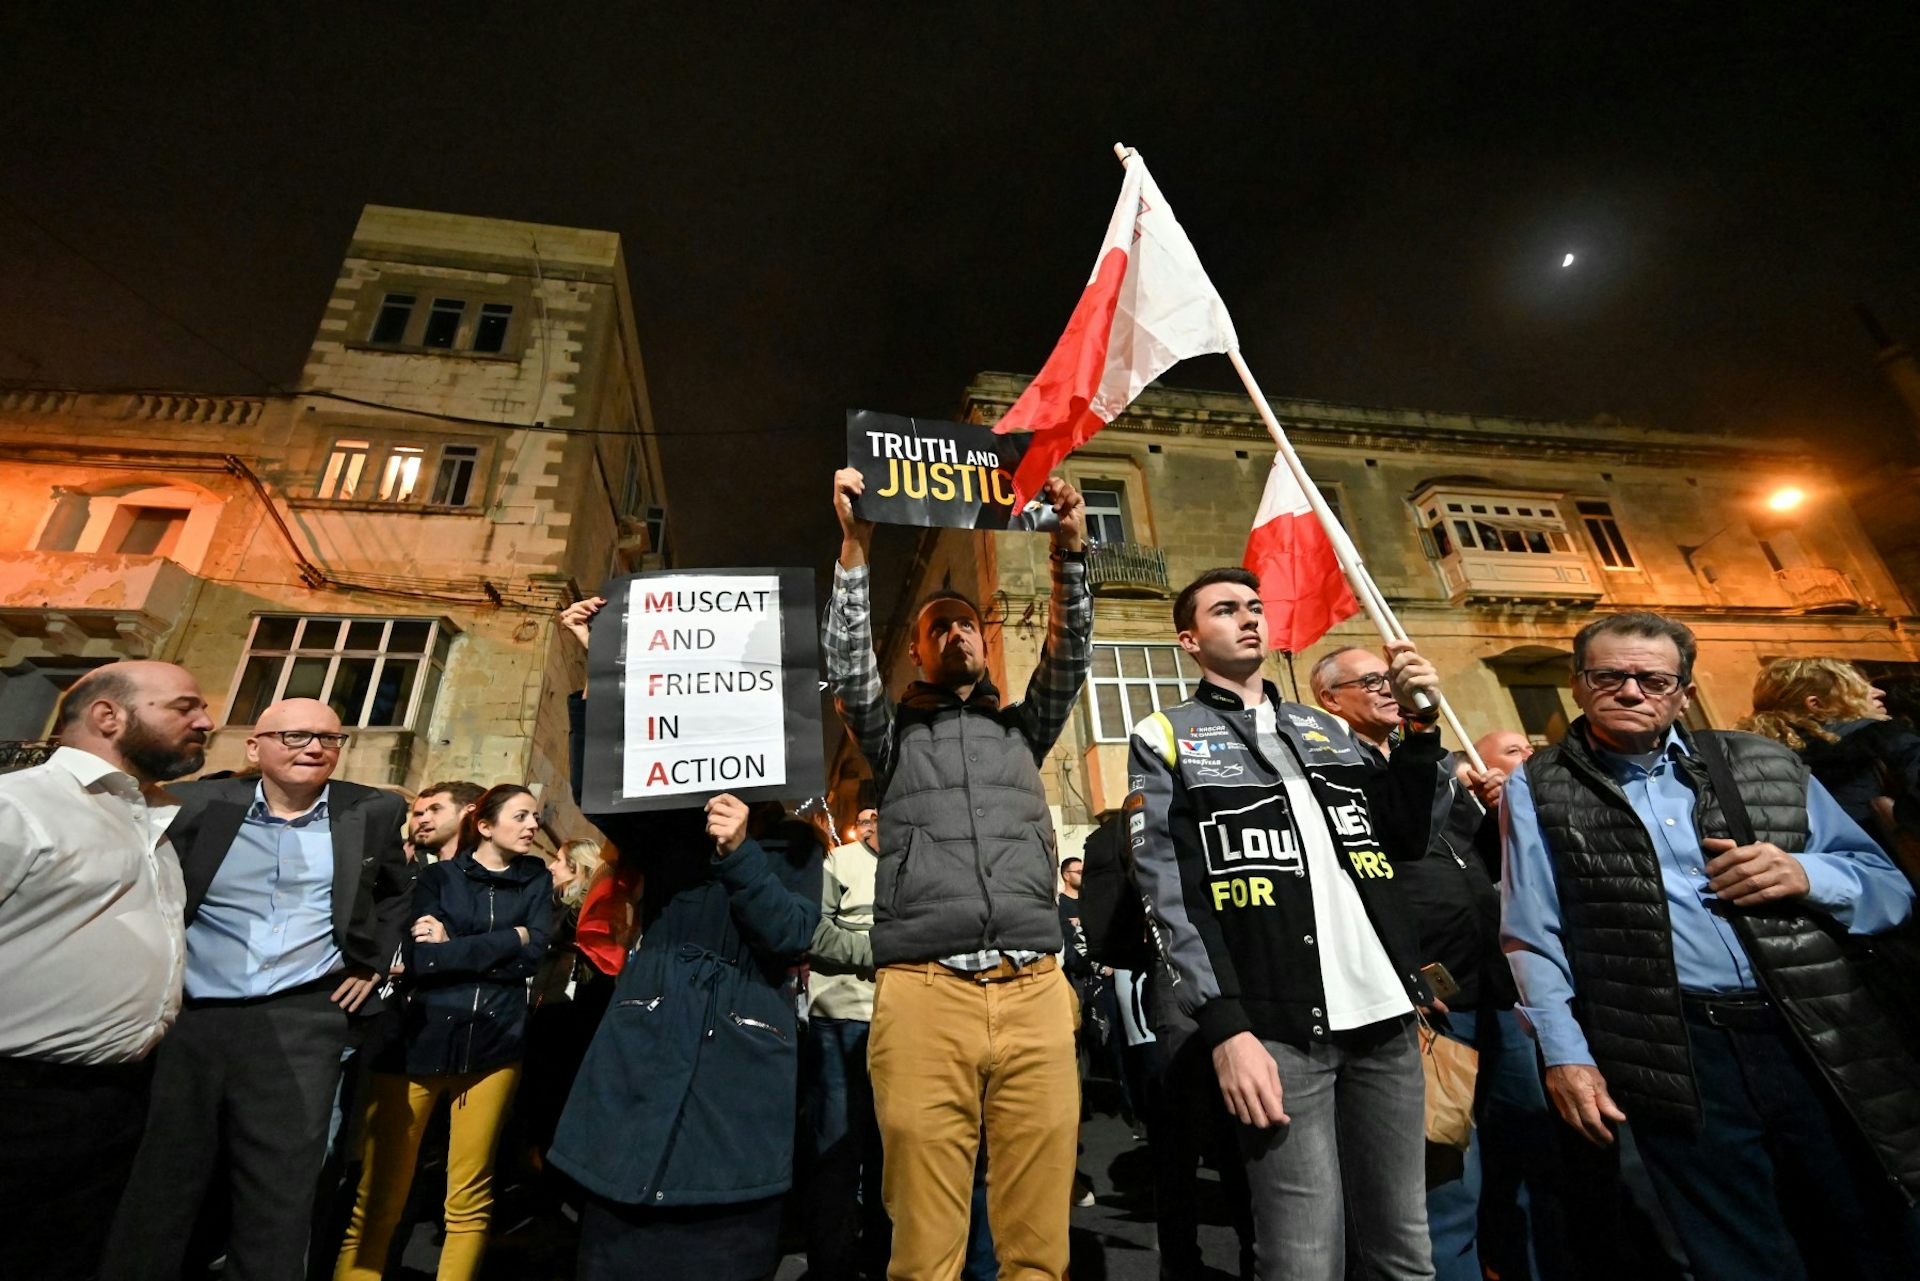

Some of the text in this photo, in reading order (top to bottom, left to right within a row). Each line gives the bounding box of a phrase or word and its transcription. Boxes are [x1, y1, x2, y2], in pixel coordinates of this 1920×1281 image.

[866, 431, 999, 469] TRUTH AND
[877, 458, 1016, 506] JUSTIC
[645, 591, 770, 613] MUSCAT
[648, 628, 716, 651] AND
[648, 670, 774, 696] FRIENDS
[648, 715, 679, 741] IN
[646, 754, 765, 787] ACTION
[1211, 850, 1394, 911] FOR PRS
